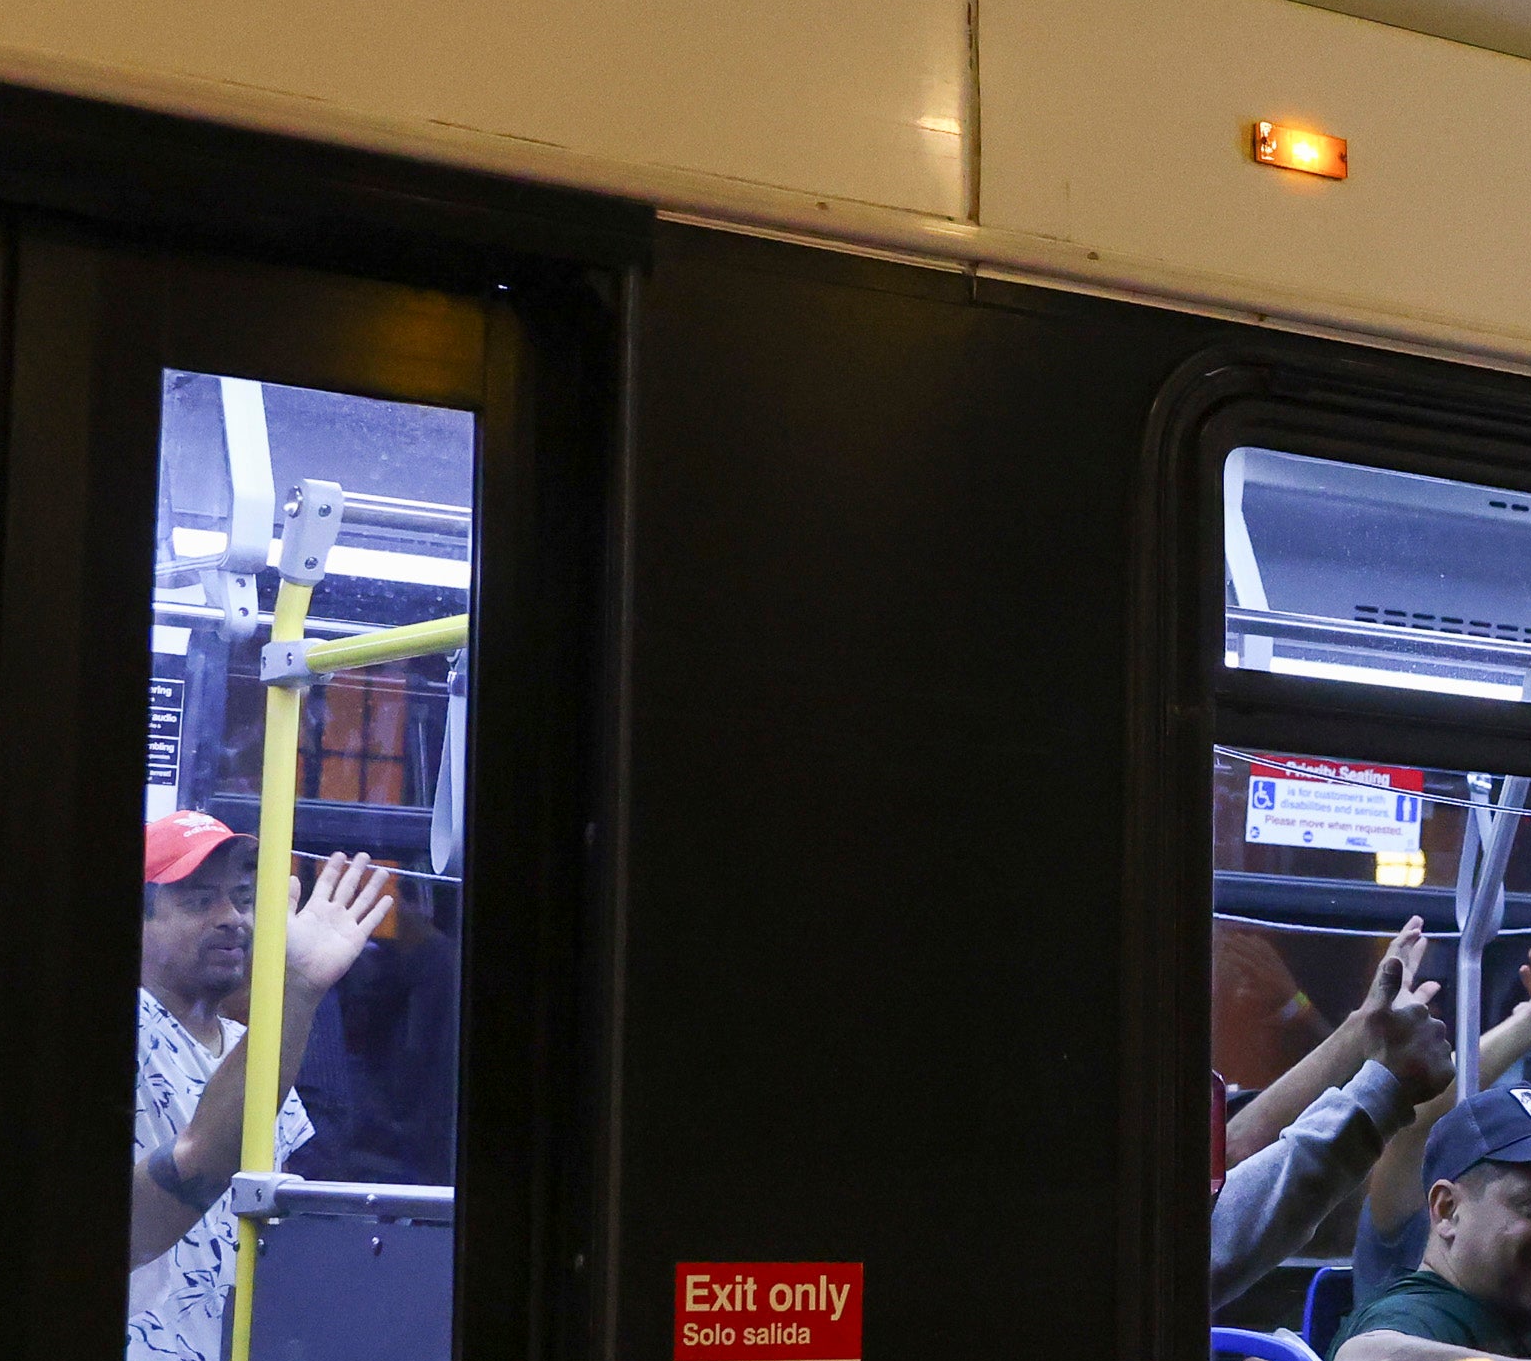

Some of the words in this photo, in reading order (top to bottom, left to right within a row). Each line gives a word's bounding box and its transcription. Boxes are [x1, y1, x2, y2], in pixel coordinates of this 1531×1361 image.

[1334, 802, 1352, 814] and
[182, 824, 227, 838] adidas
[1265, 814, 1297, 827] Please
[1299, 818, 1325, 829] move
[1328, 820, 1353, 832] when
[685, 1274, 757, 1312] Exit
[769, 1274, 851, 1321] only
[682, 1323, 736, 1346] Solo
[743, 1323, 811, 1345] salida
